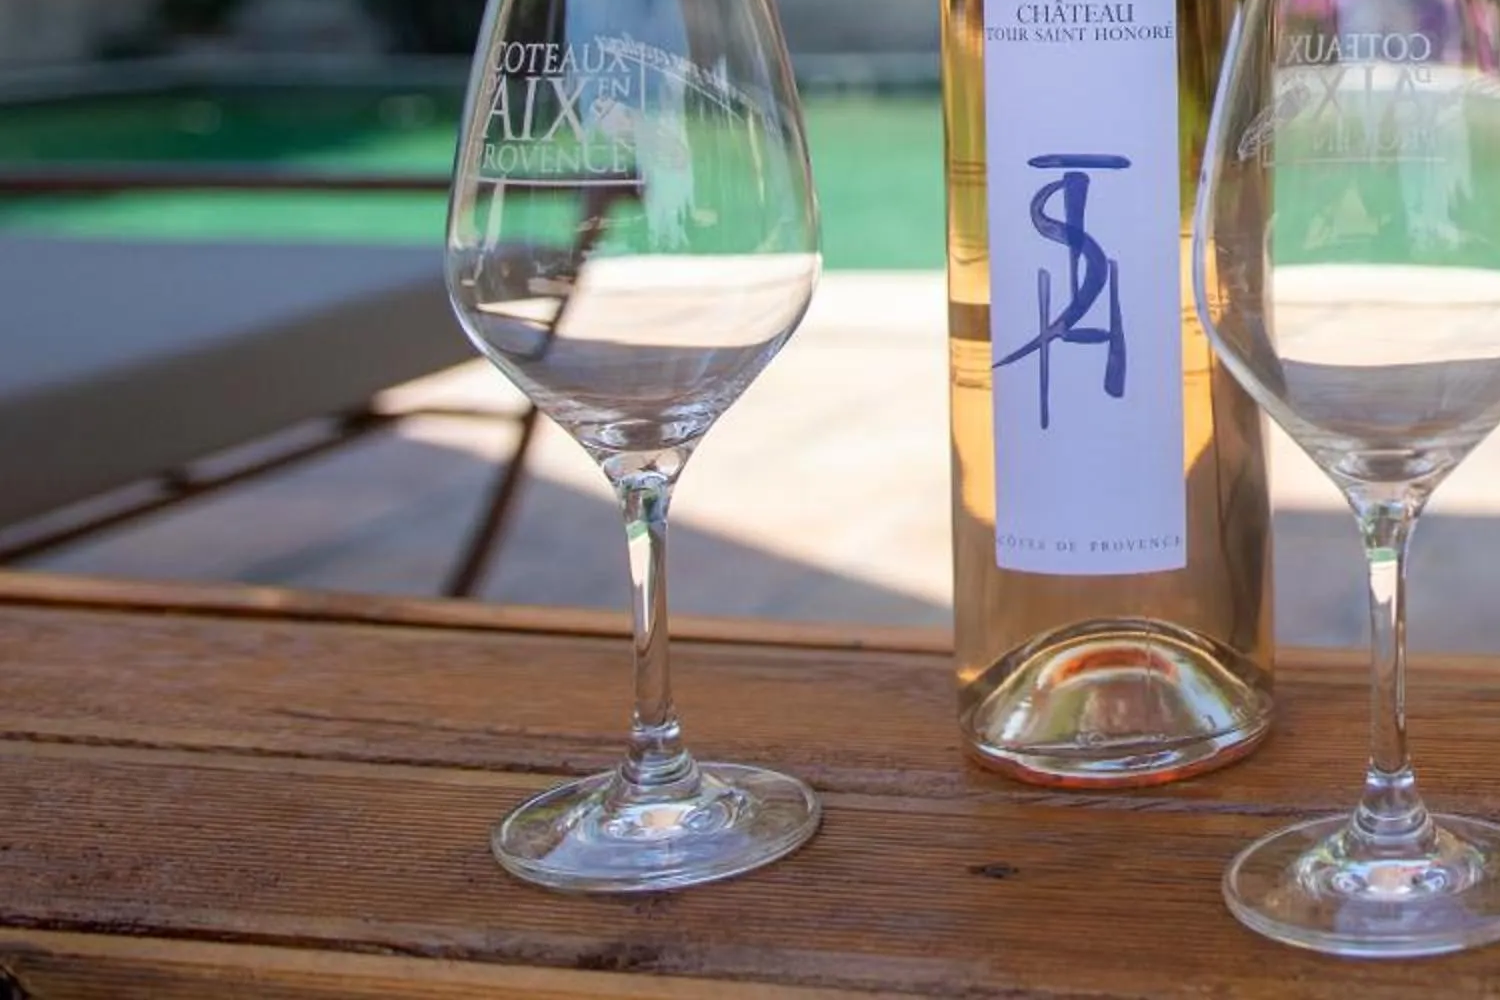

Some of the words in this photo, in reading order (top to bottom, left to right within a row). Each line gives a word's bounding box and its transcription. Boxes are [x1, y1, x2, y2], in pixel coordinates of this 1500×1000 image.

[986, 26, 1029, 42] TOUR
[1034, 27, 1087, 43] SAINT
[491, 40, 631, 74] COTEAUX
[597, 75, 631, 98] EN
[475, 142, 629, 174] ROVENCE
[1056, 540, 1077, 553] DE
